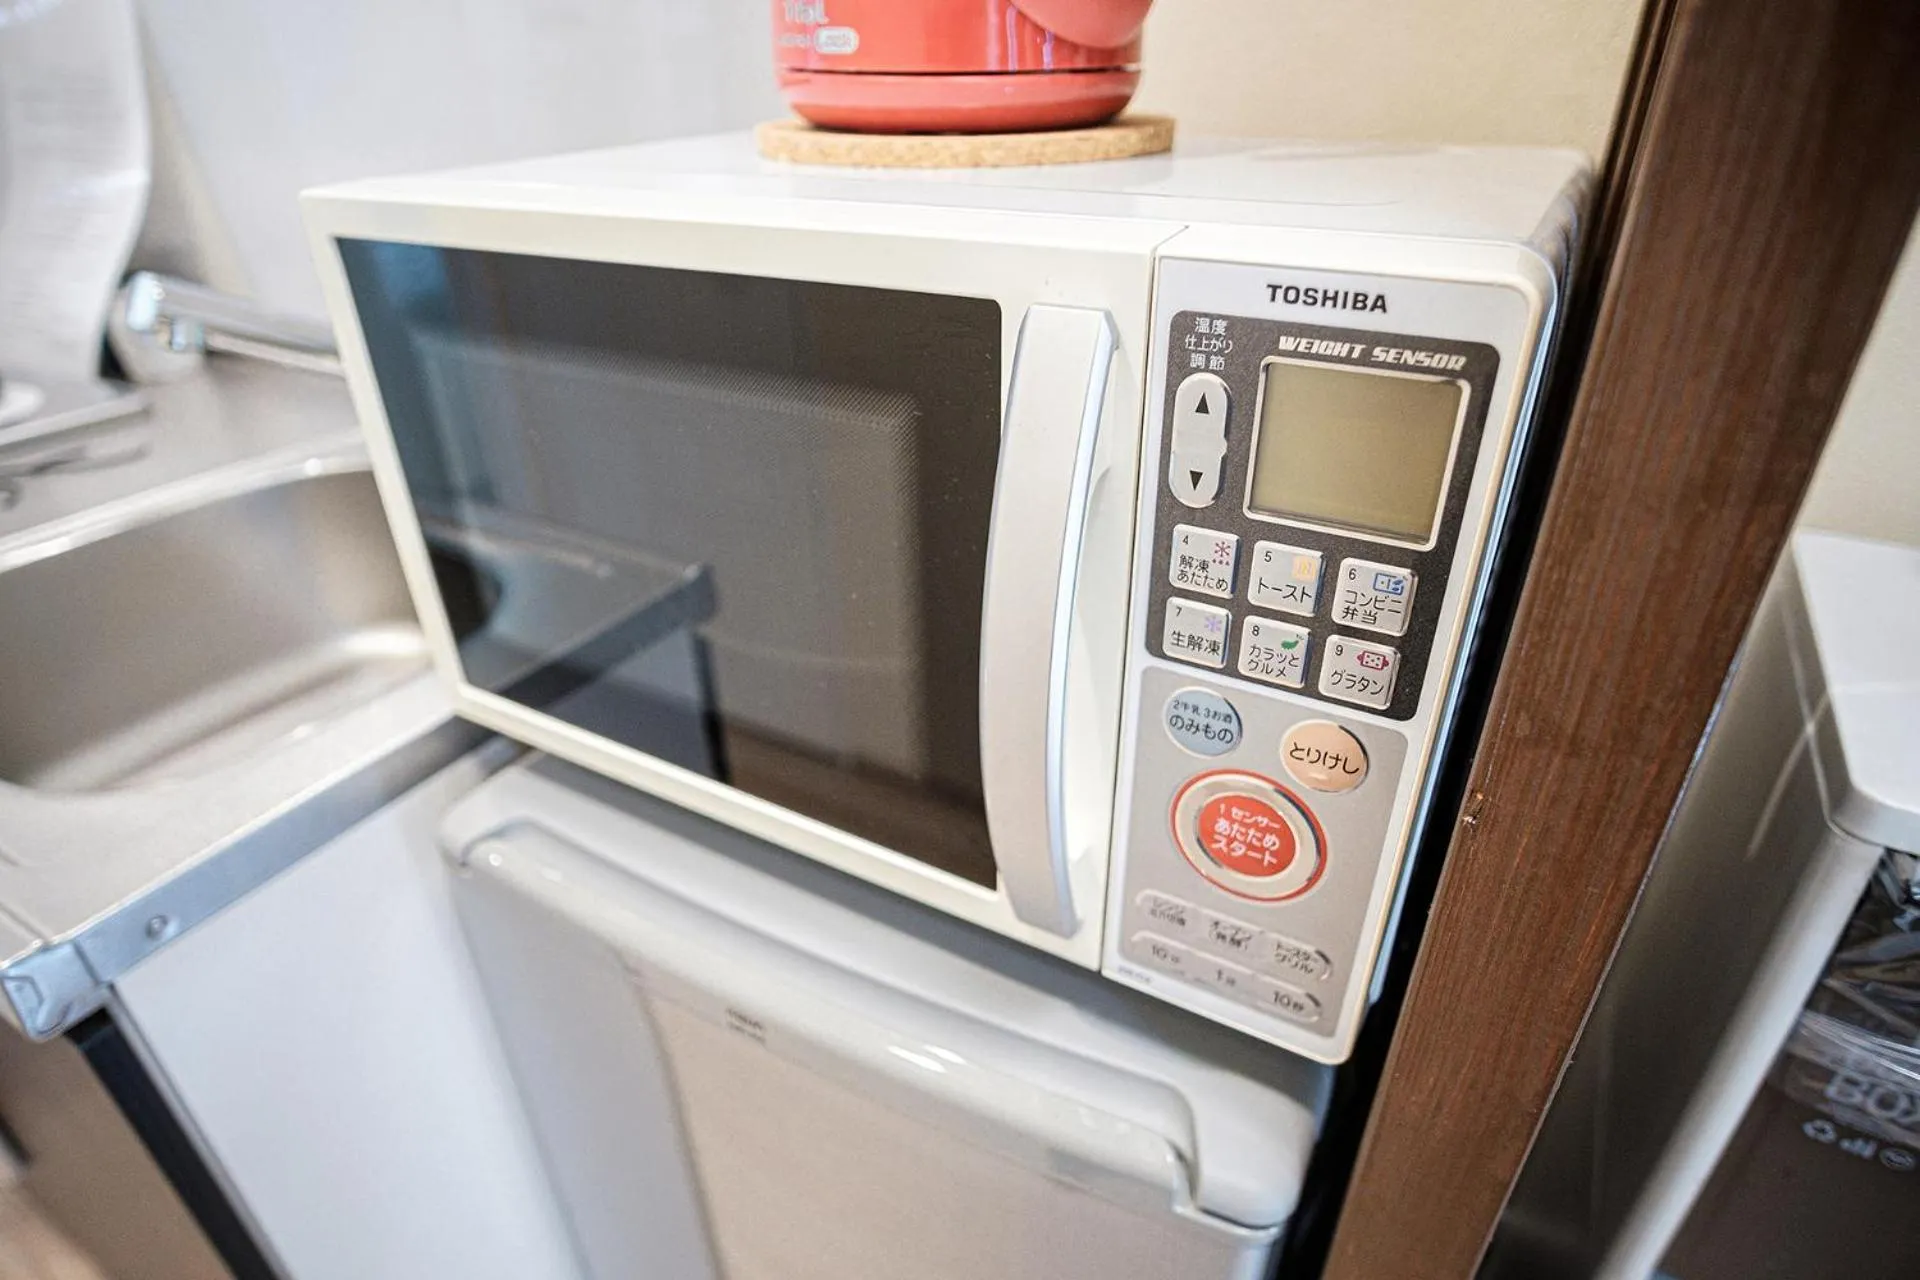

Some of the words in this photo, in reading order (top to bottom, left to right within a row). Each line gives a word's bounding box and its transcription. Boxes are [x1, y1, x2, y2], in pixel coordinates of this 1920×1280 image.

[1266, 284, 1388, 313] TOSHIBA
[1195, 317, 1228, 336] 温度
[1184, 334, 1233, 354] 仕上がり
[1278, 335, 1366, 359] WEIGHT
[1370, 346, 1467, 371] SENSOR
[1190, 353, 1226, 371] 調節
[1182, 535, 1189, 546] 4
[1178, 554, 1209, 574] 解凍
[1264, 551, 1272, 563] 5
[1176, 568, 1229, 592] あたため
[1348, 568, 1356, 581] 6
[1257, 577, 1313, 603] トースト
[1175, 606, 1182, 617] 7
[1344, 589, 1402, 615] コンビニ
[1342, 606, 1377, 625] 弁当
[1252, 625, 1260, 637] 8
[1170, 630, 1222, 656] 生解凍
[1335, 645, 1343, 656] 9
[1247, 658, 1288, 678] グルメ
[1249, 645, 1300, 668] カラッと
[1330, 670, 1385, 696] グラタン
[1169, 714, 1234, 745] のみもの
[1289, 742, 1360, 775] とりけし
[1231, 806, 1281, 829] センサー
[1214, 818, 1280, 851] あたため
[1211, 834, 1277, 867] スタート
